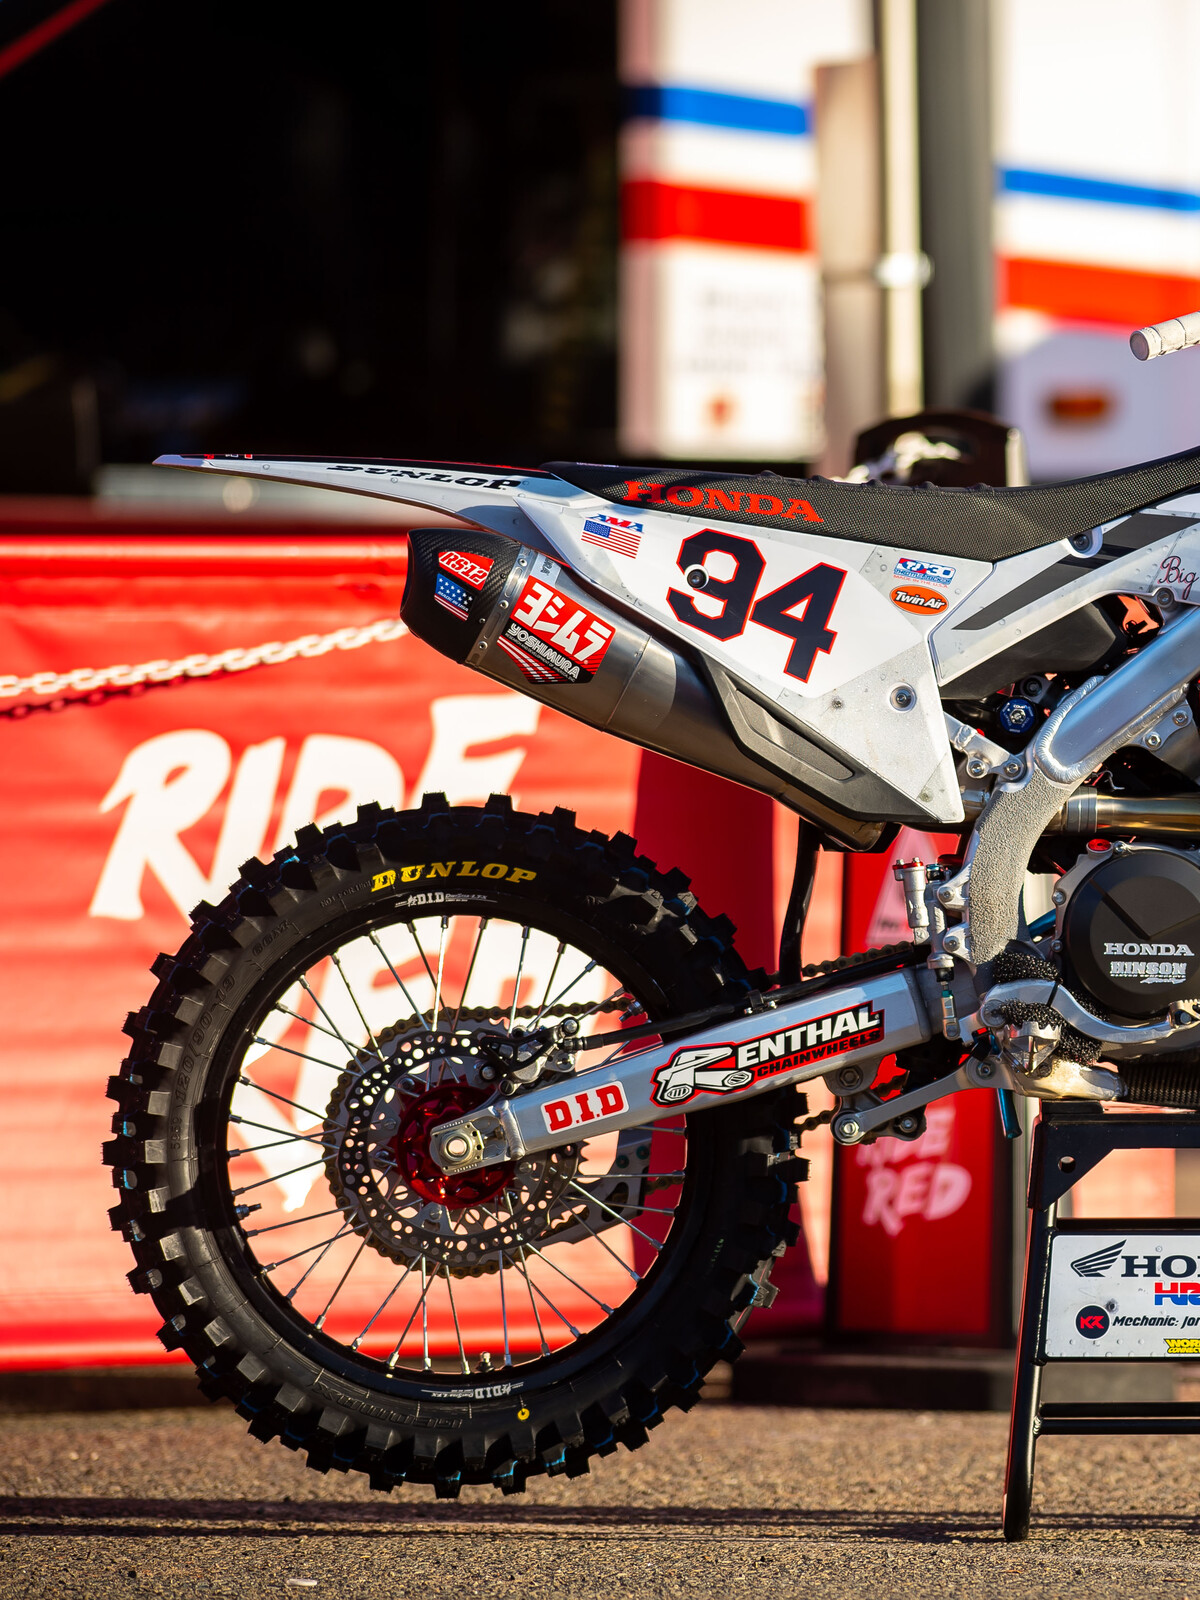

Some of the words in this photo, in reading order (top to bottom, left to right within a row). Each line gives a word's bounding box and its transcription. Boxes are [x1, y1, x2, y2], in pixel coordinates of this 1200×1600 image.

[326, 465, 522, 490] DUNLOP
[587, 513, 644, 534] AMA
[623, 480, 824, 524] HONDA
[1157, 556, 1199, 599] Big
[667, 528, 847, 683] 94
[895, 590, 925, 605] Twin
[924, 598, 945, 609] Air
[508, 623, 579, 679] YOSHIMURA
[89, 694, 541, 920] RIDE
[371, 860, 537, 892] DUNLOP
[1103, 943, 1195, 956] HONDA
[1110, 961, 1187, 975] HINSON
[757, 1028, 881, 1079] CHAINWHEELS
[545, 1085, 627, 1131] D.I.D
[862, 1160, 972, 1237] RED
[1112, 1315, 1179, 1327] Mechanic:
